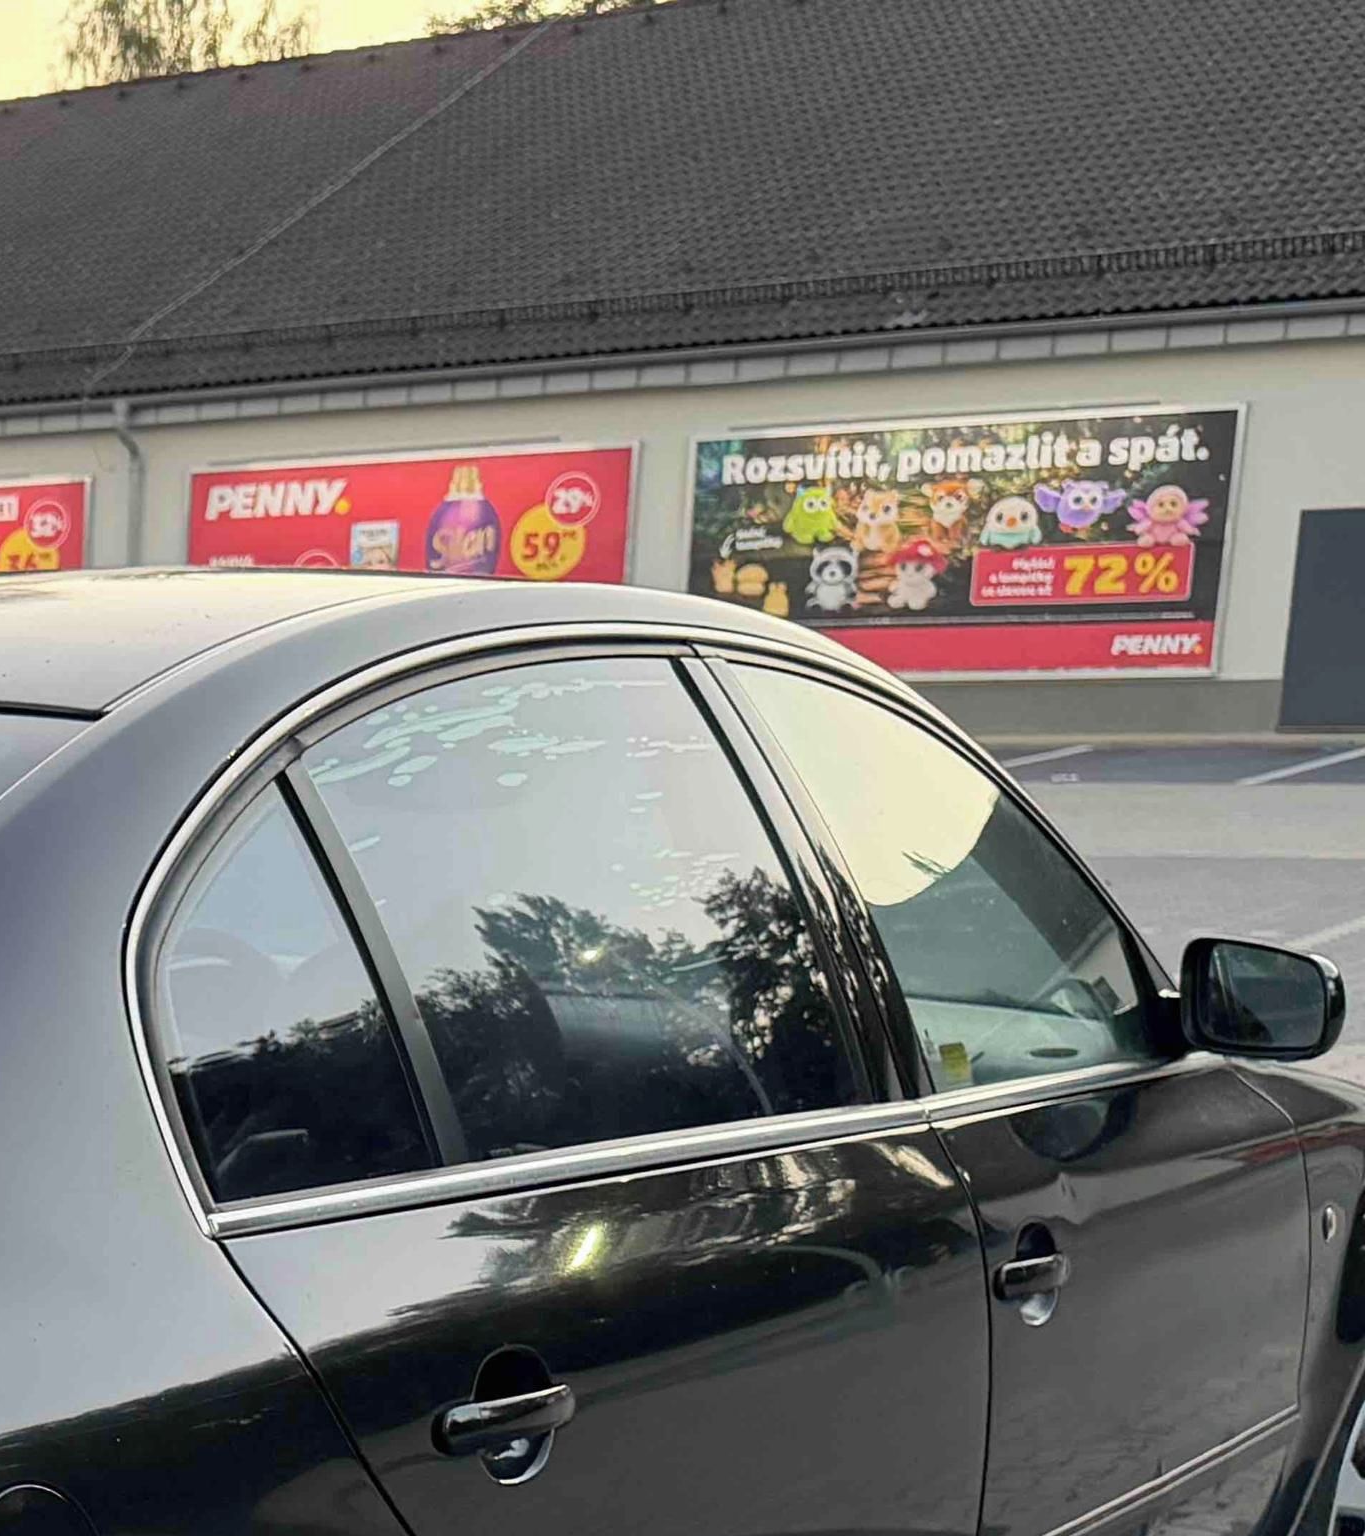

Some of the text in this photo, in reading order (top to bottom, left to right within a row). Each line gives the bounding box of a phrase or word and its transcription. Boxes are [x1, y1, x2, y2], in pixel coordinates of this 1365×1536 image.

[721, 424, 1211, 486] Rozsvítit, pomazlit a spát.
[1063, 553, 1129, 596] 72
